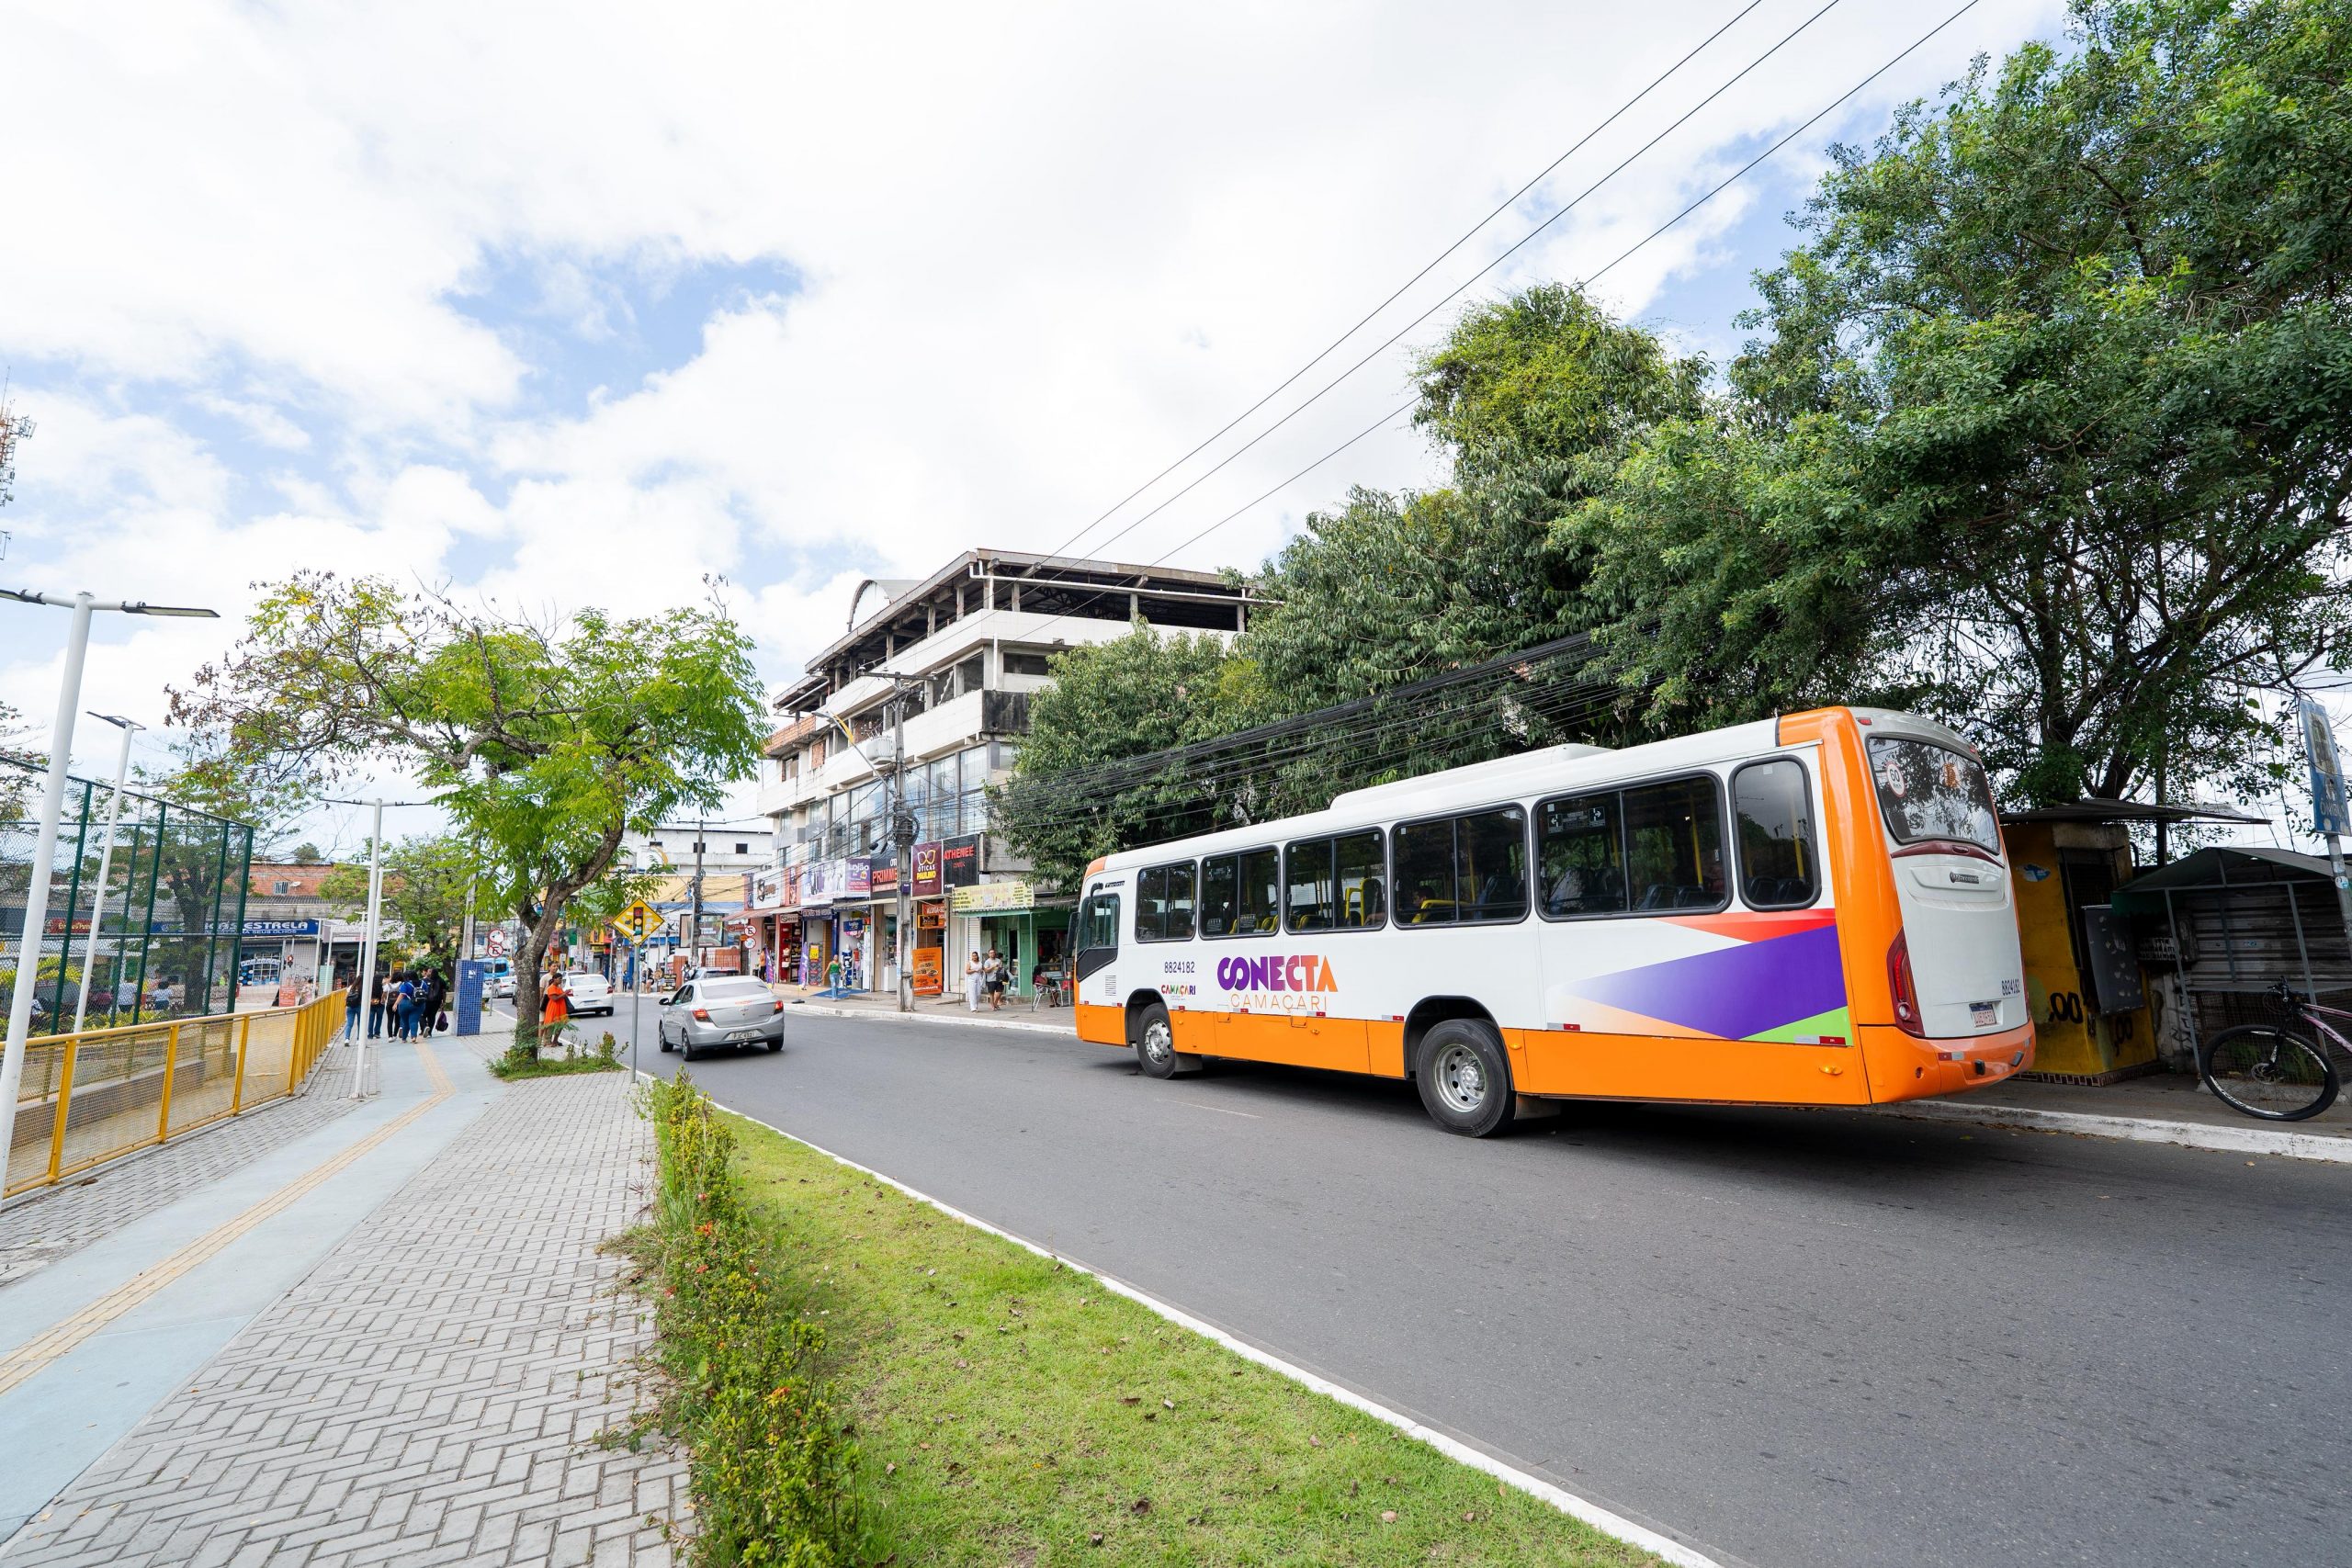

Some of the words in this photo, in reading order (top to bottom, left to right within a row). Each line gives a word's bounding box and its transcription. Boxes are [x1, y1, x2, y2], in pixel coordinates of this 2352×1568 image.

[1890, 769, 1900, 782] 60
[1164, 961, 1194, 974] 8824182
[1217, 955, 1338, 992] CONECTA
[1160, 984, 1196, 997] CAMAÇARI
[2001, 979, 2020, 996] 8824182
[1231, 993, 1327, 1013] CAMAÇARI
